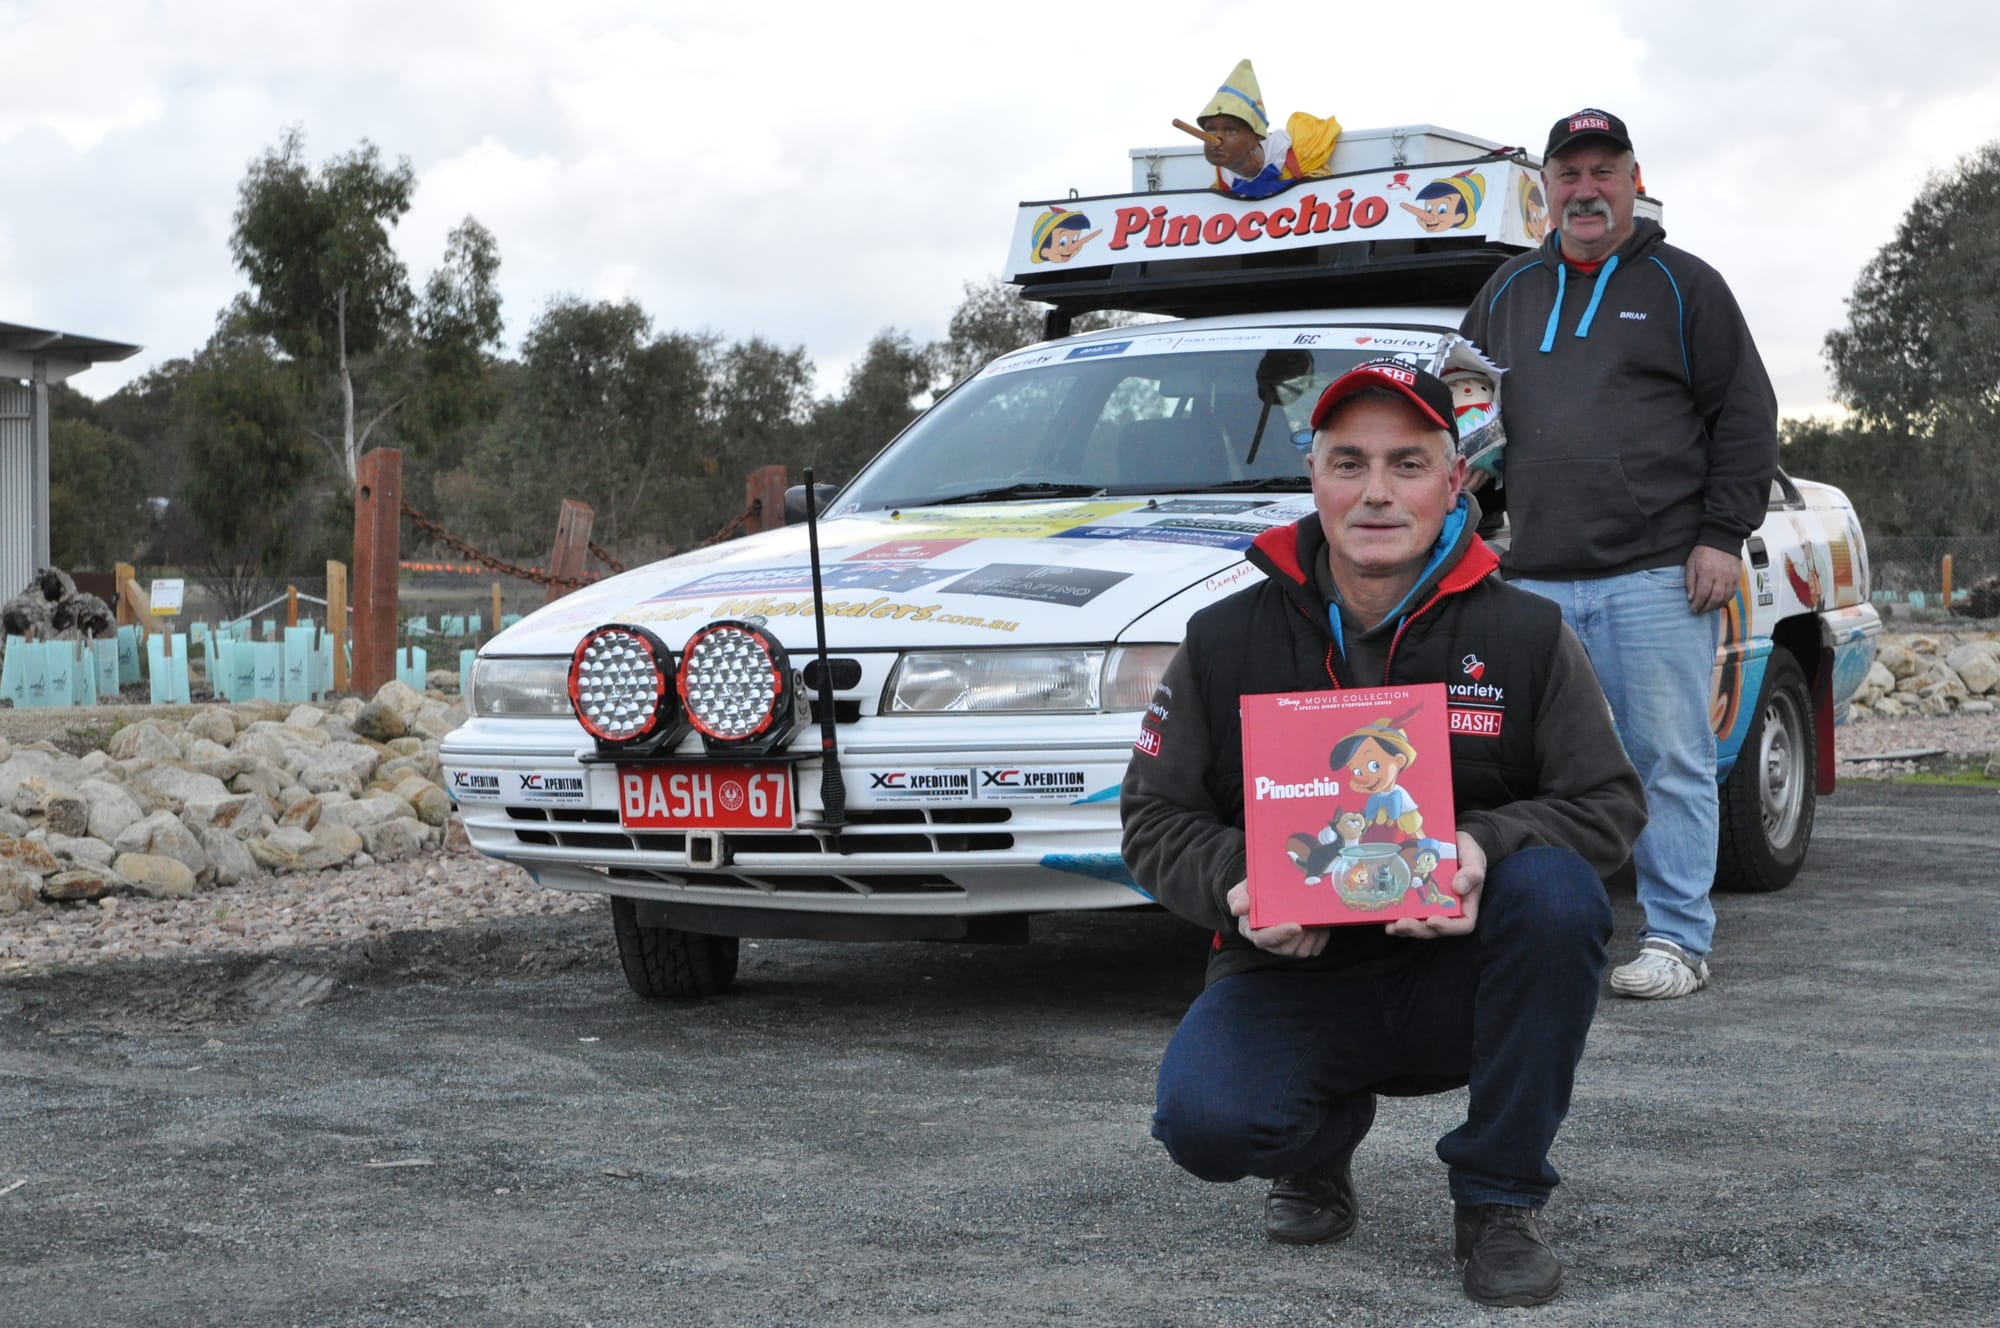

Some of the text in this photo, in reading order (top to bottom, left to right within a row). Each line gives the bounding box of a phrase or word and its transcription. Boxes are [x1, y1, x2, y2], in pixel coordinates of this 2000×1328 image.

[1575, 118, 1604, 130] BASH
[1109, 188, 1389, 250] Pinocchio
[1620, 311, 1647, 320] BRIAN
[1373, 336, 1437, 349] variety
[1276, 691, 1409, 707] Disney MOVIE COLLECTION
[1451, 712, 1495, 733] BASH
[1139, 729, 1154, 751] SH
[470, 775, 499, 789] XPEDITION
[544, 777, 583, 791] XPEDITION
[910, 774, 968, 789] XPEDITION
[1024, 772, 1085, 786] XPEDITION
[623, 773, 785, 818] BASH 67
[1255, 776, 1339, 800] Pinocchio
